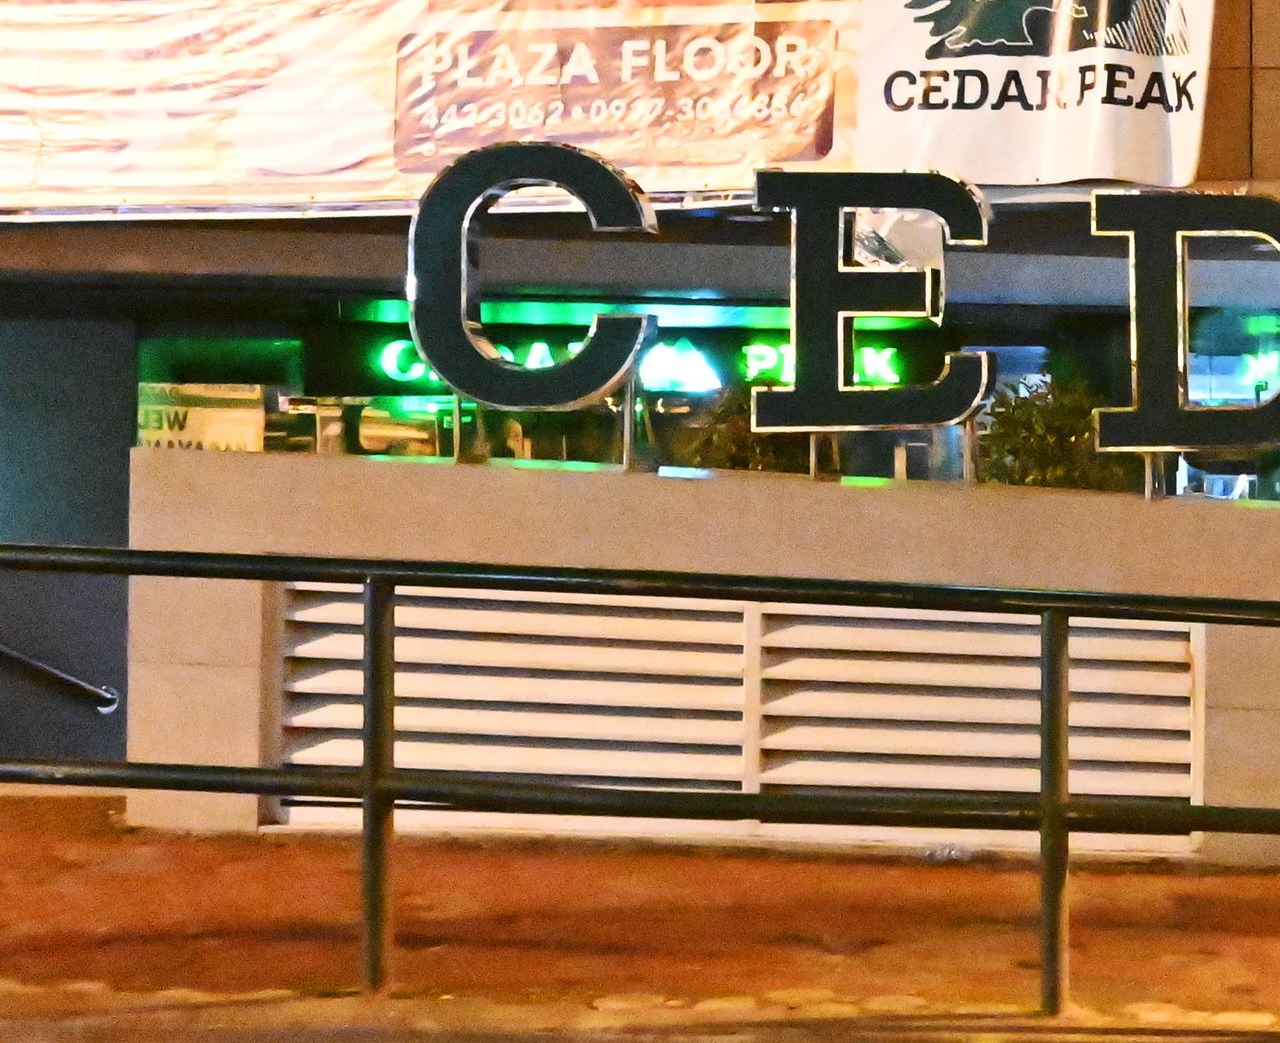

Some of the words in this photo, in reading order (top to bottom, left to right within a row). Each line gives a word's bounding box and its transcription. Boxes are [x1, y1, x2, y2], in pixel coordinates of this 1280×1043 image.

[419, 41, 600, 89] PLAZA
[619, 34, 815, 84] FLOOR
[883, 69, 1068, 112] CEDAR
[1076, 63, 1197, 113] PEAK
